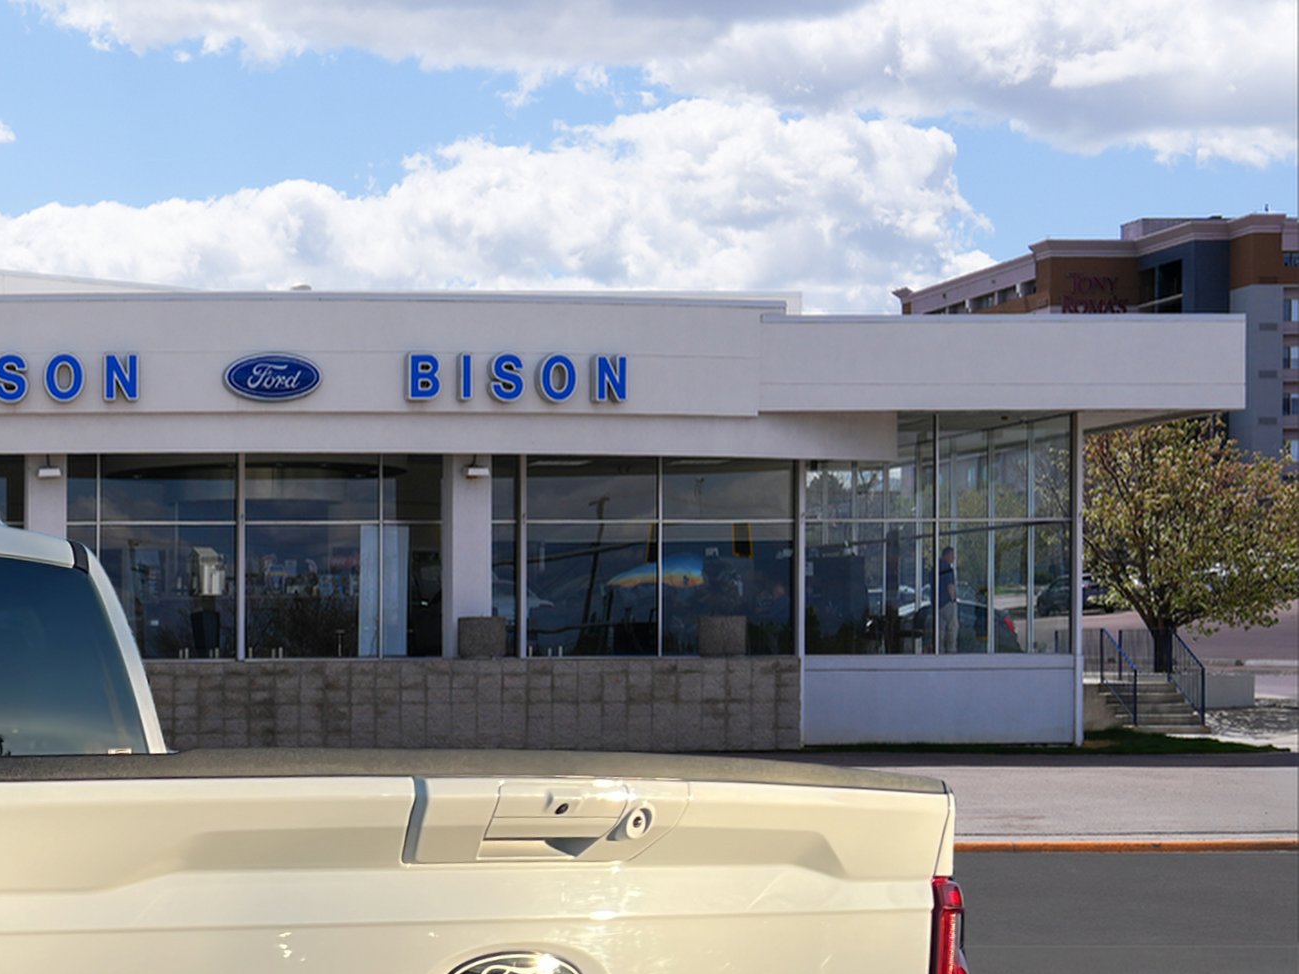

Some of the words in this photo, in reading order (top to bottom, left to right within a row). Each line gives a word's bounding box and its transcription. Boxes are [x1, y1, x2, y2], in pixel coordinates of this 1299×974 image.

[1066, 271, 1120, 293] TONY
[247, 363, 301, 389] Ford
[406, 352, 628, 404] BISON
